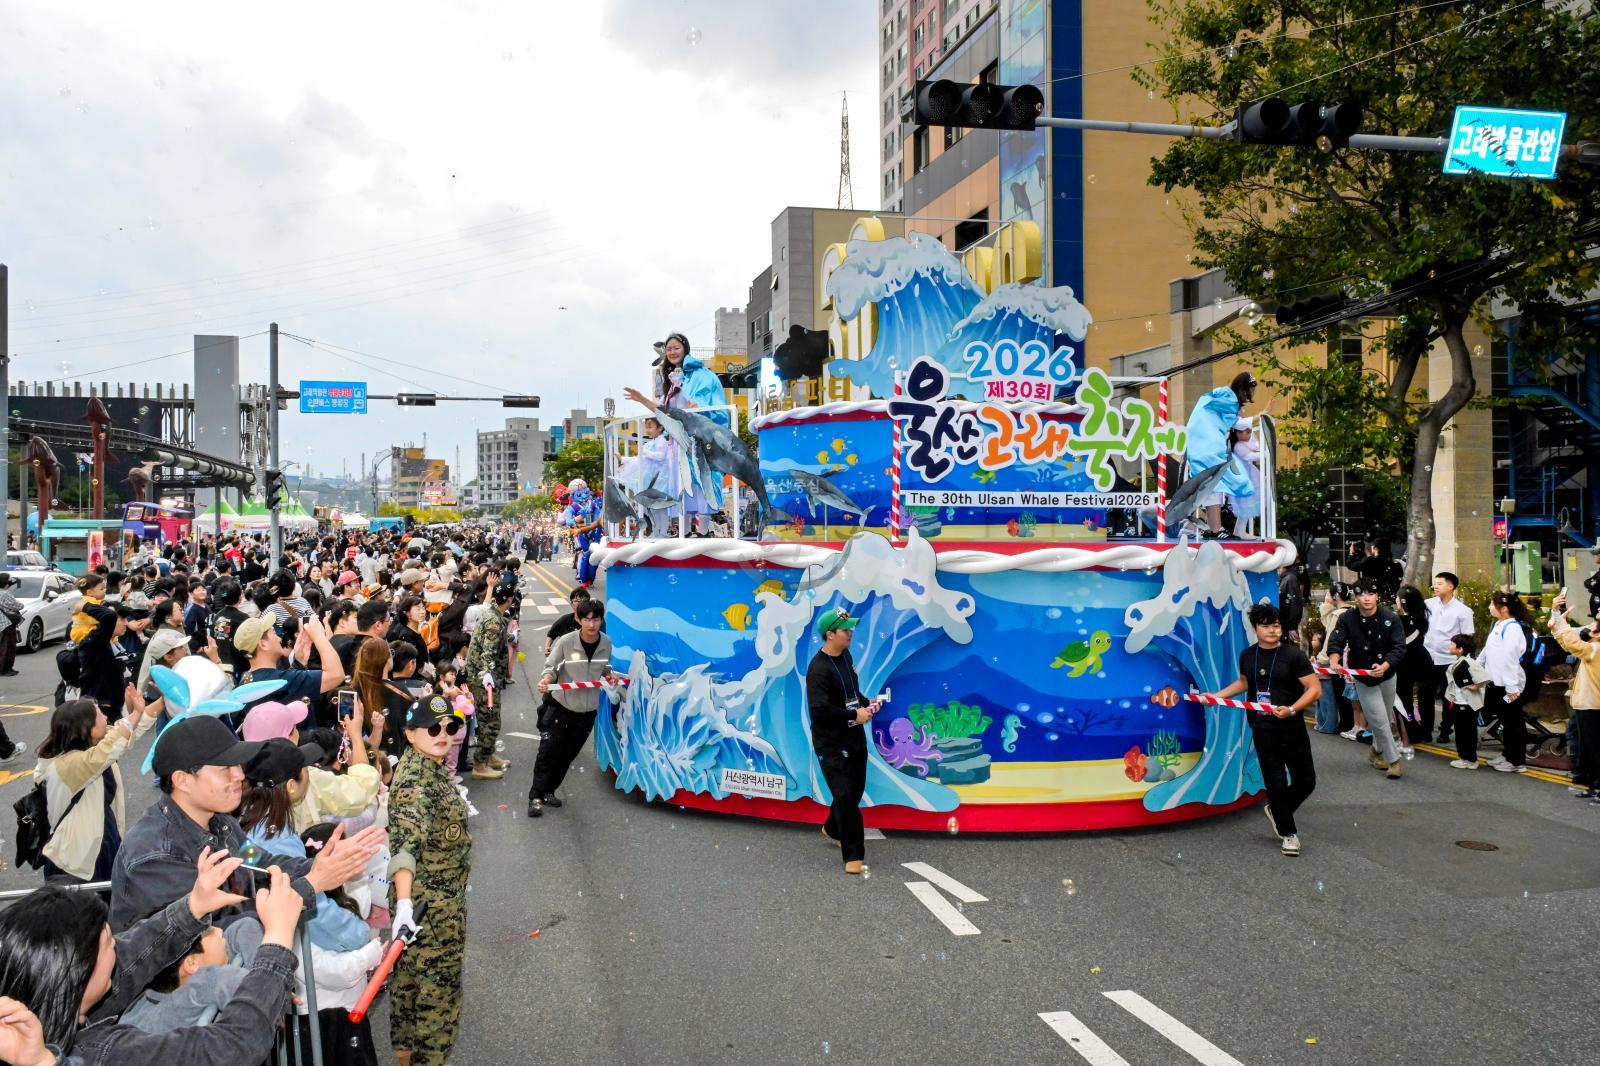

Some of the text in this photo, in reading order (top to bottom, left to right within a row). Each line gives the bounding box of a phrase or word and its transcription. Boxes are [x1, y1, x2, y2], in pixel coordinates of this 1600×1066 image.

[966, 343, 1073, 382] 2026
[987, 381, 1052, 400] 제30회
[910, 493, 936, 504] The
[942, 493, 972, 505] 30th
[978, 493, 1015, 505] Ulsan
[1020, 493, 1058, 506] Whale
[767, 777, 784, 789] 남구
